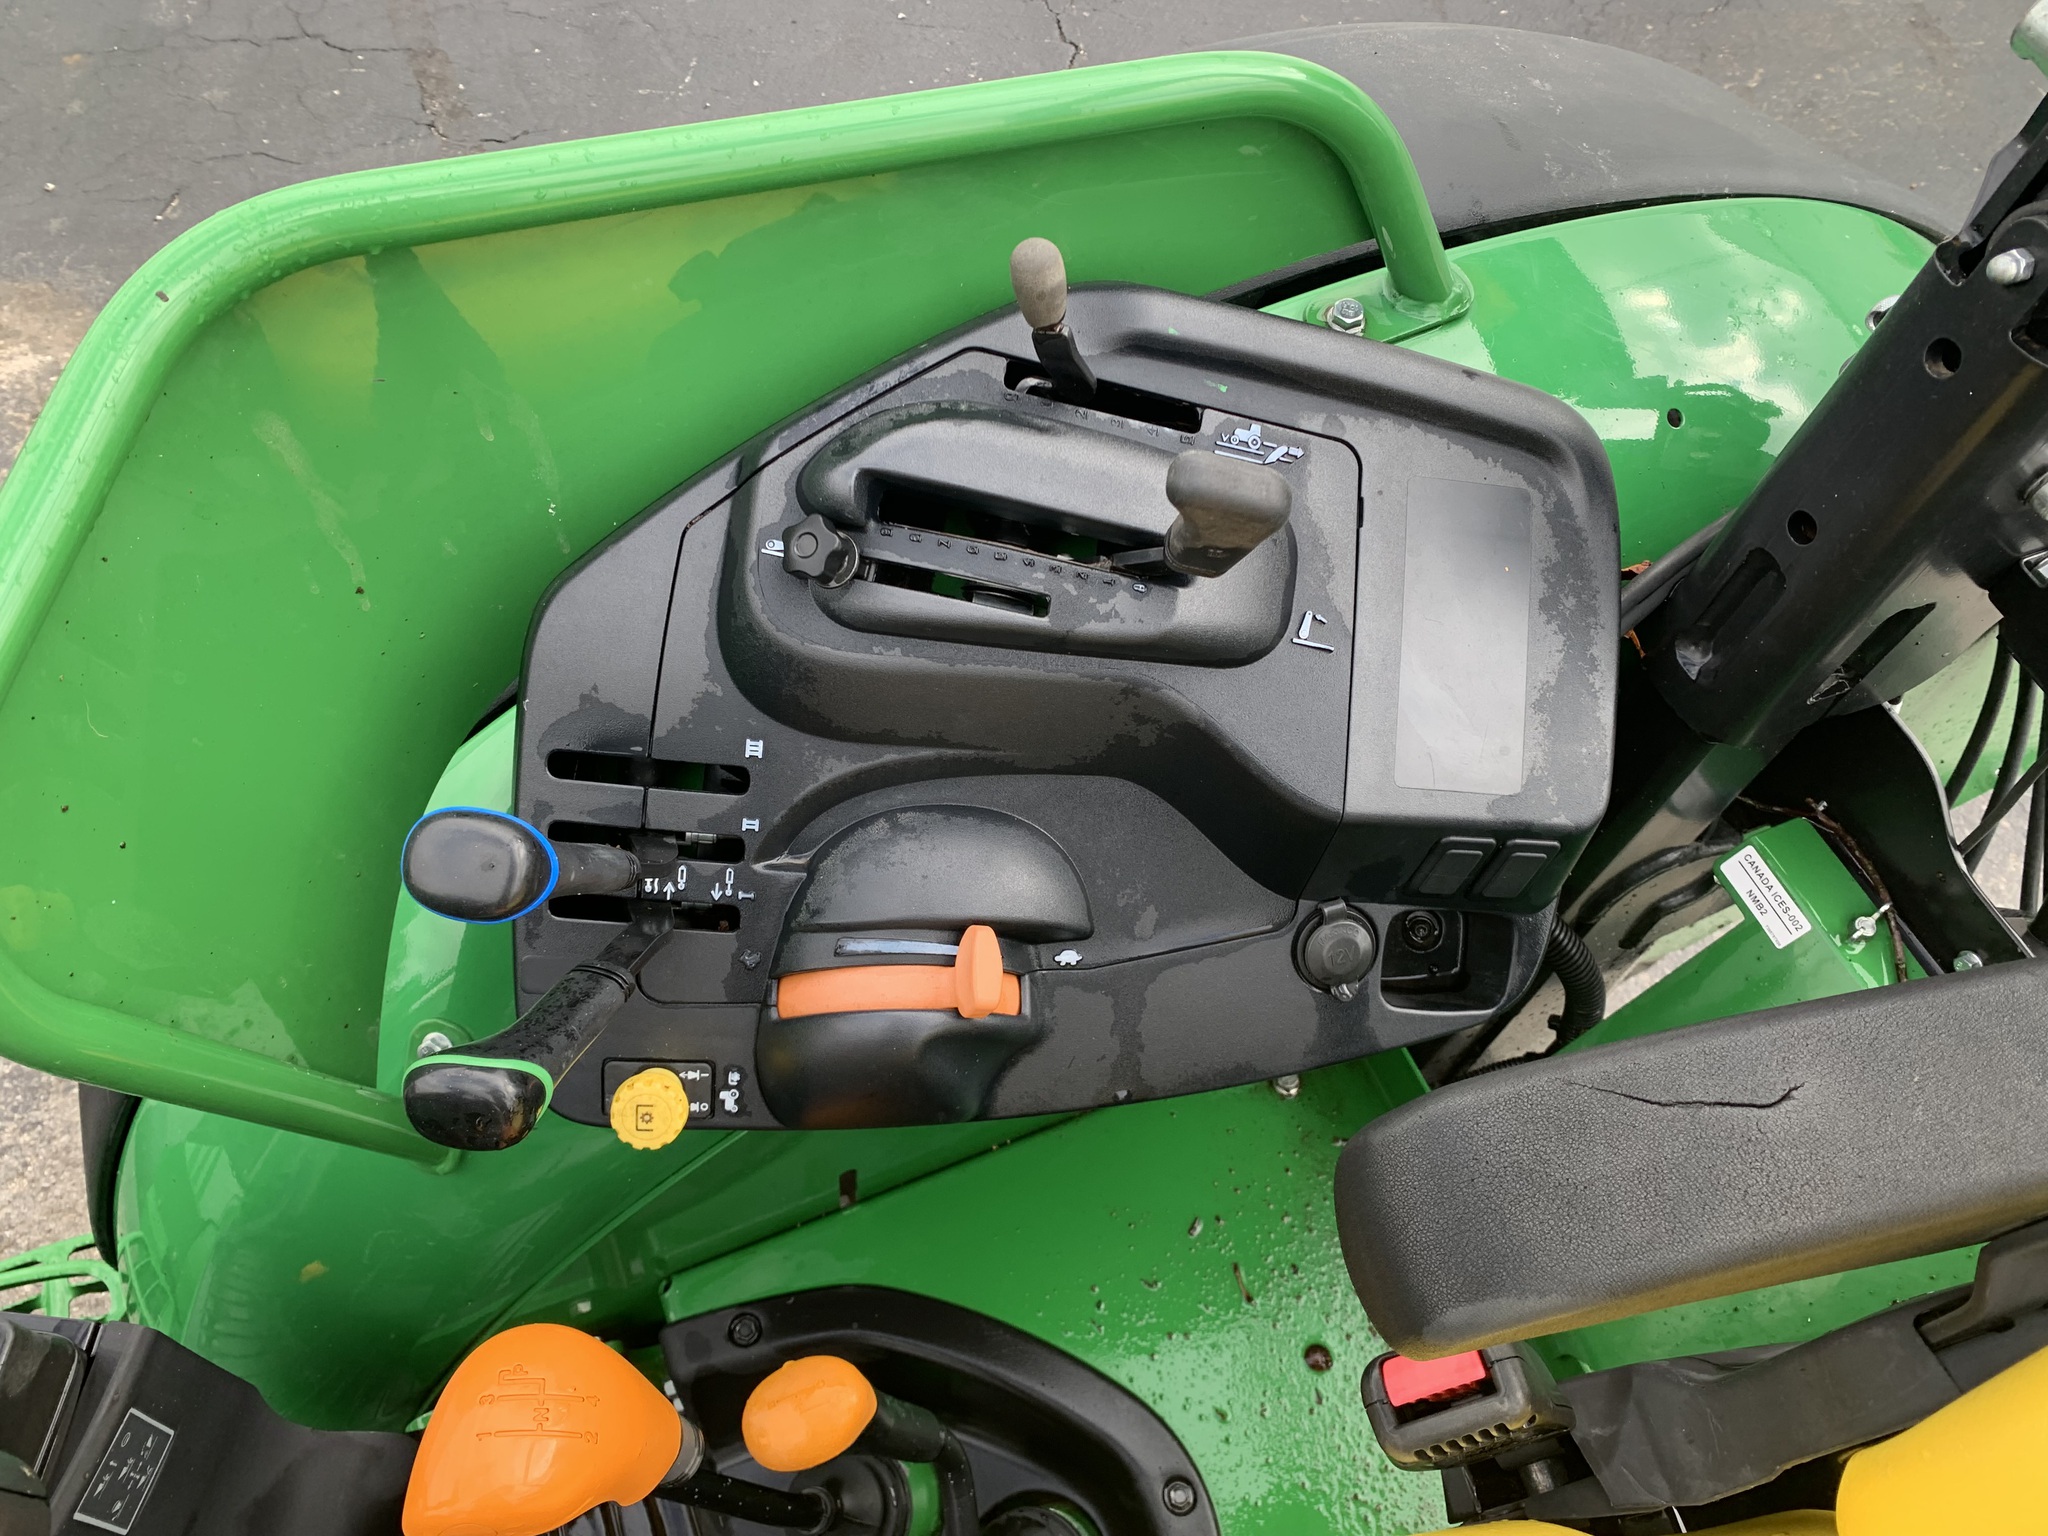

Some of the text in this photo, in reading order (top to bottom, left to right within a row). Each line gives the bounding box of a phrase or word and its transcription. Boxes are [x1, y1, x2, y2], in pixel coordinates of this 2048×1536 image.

[1743, 853, 1774, 893] CANADA
[1770, 891, 1804, 932] ICES-002
[1746, 889, 1769, 917] NMB2
[1327, 944, 1355, 967] 12V
[512, 1363, 529, 1376] P
[478, 1393, 496, 1405] 3
[585, 1395, 600, 1407] 4
[532, 1407, 550, 1422] N
[476, 1432, 492, 1442] 1
[583, 1430, 599, 1445] 2
